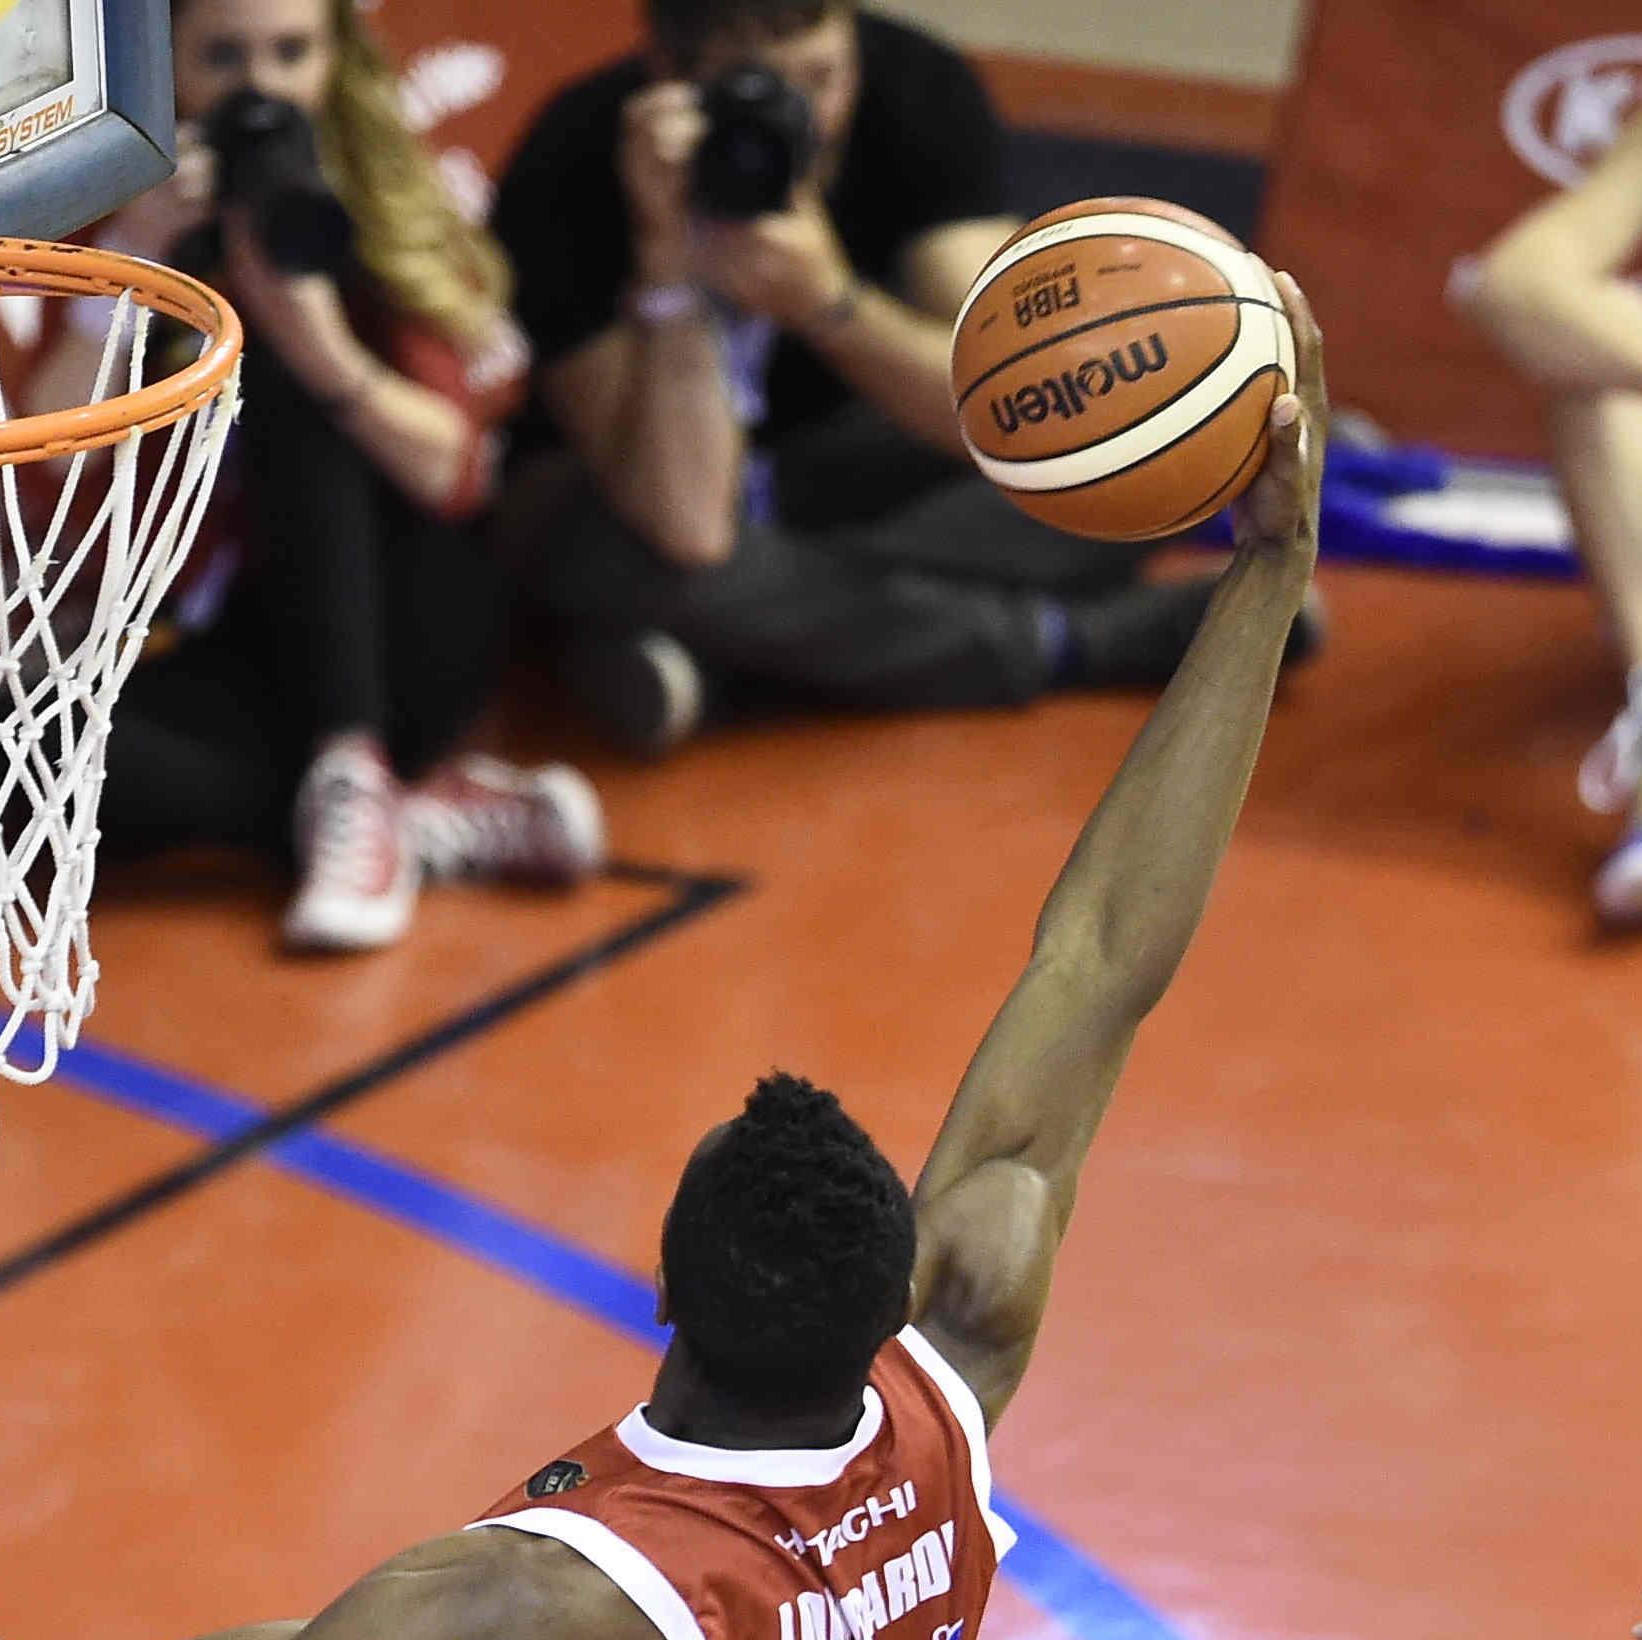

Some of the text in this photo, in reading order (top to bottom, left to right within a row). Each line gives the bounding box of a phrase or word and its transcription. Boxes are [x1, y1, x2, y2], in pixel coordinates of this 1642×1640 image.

[1013, 275, 1081, 328] FIBA
[989, 331, 1168, 433] molten
[773, 1479, 917, 1567] HTACHI
